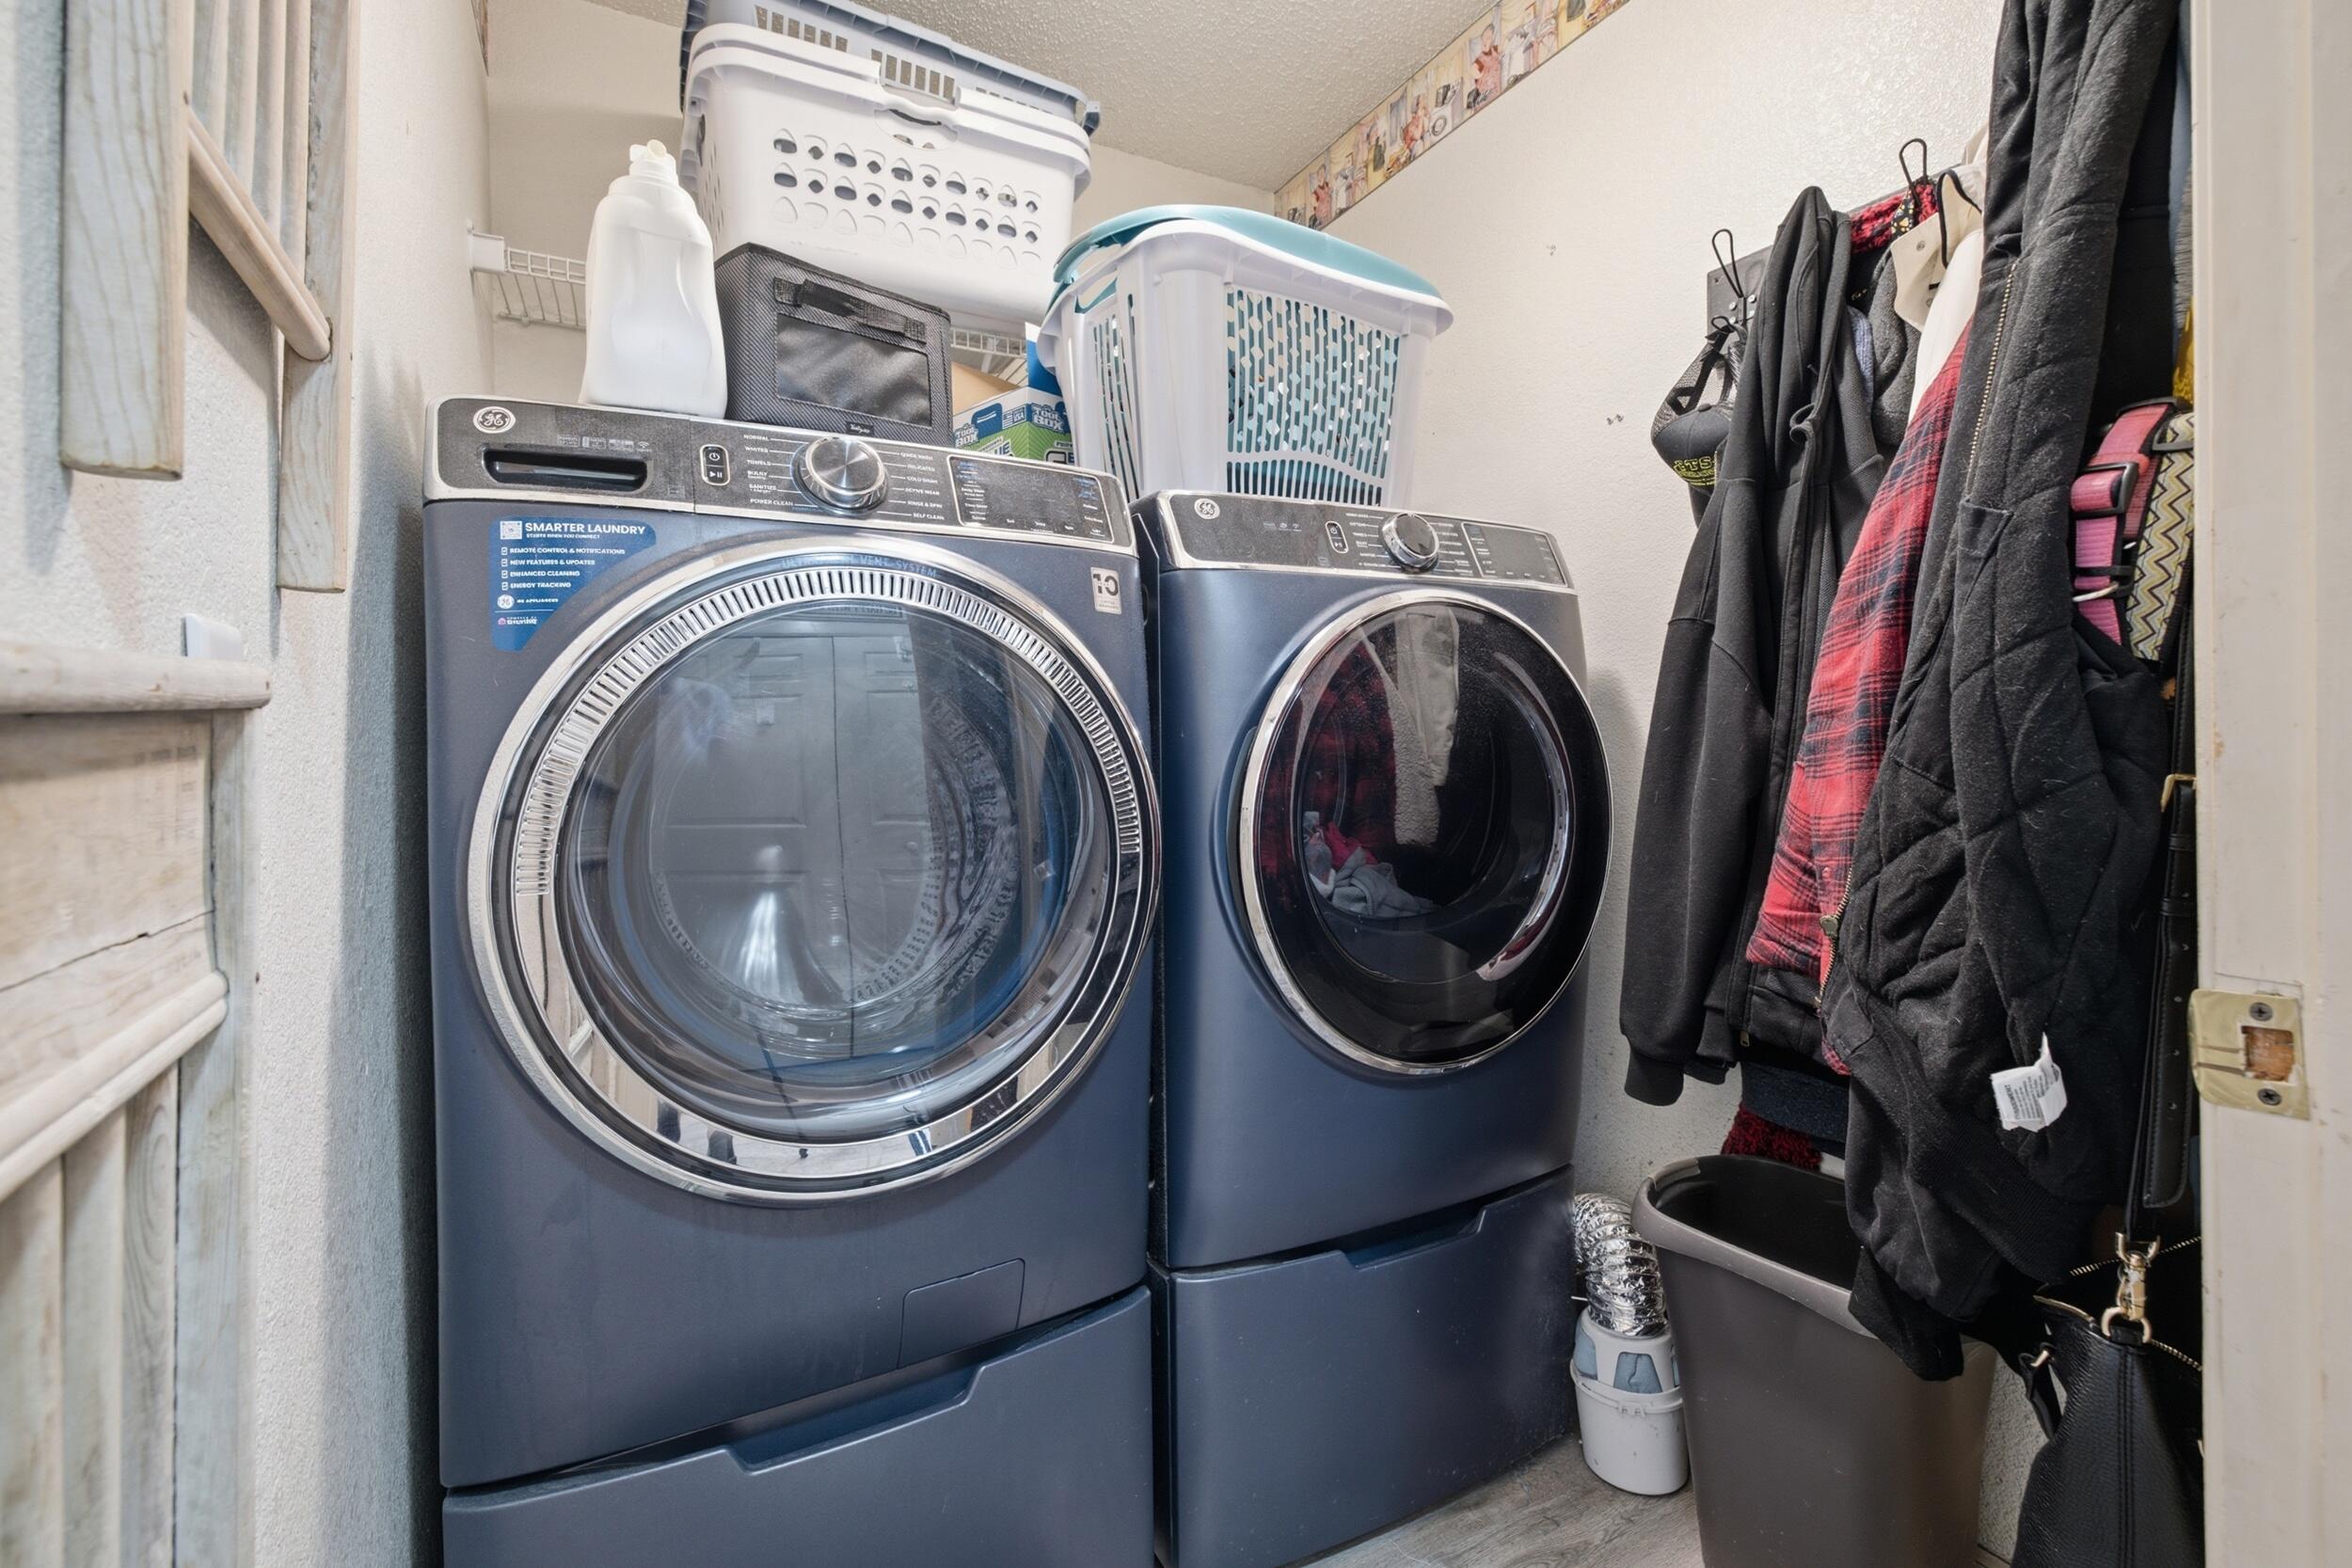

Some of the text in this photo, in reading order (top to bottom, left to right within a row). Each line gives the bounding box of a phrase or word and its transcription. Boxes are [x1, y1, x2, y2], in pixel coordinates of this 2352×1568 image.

[1032, 406, 1061, 420] TOOL
[1033, 414, 1064, 432] BOX
[955, 434, 978, 447] BOX
[525, 523, 646, 535] SMARTER LAUNDRY
[895, 560, 937, 578] SYSTEM
